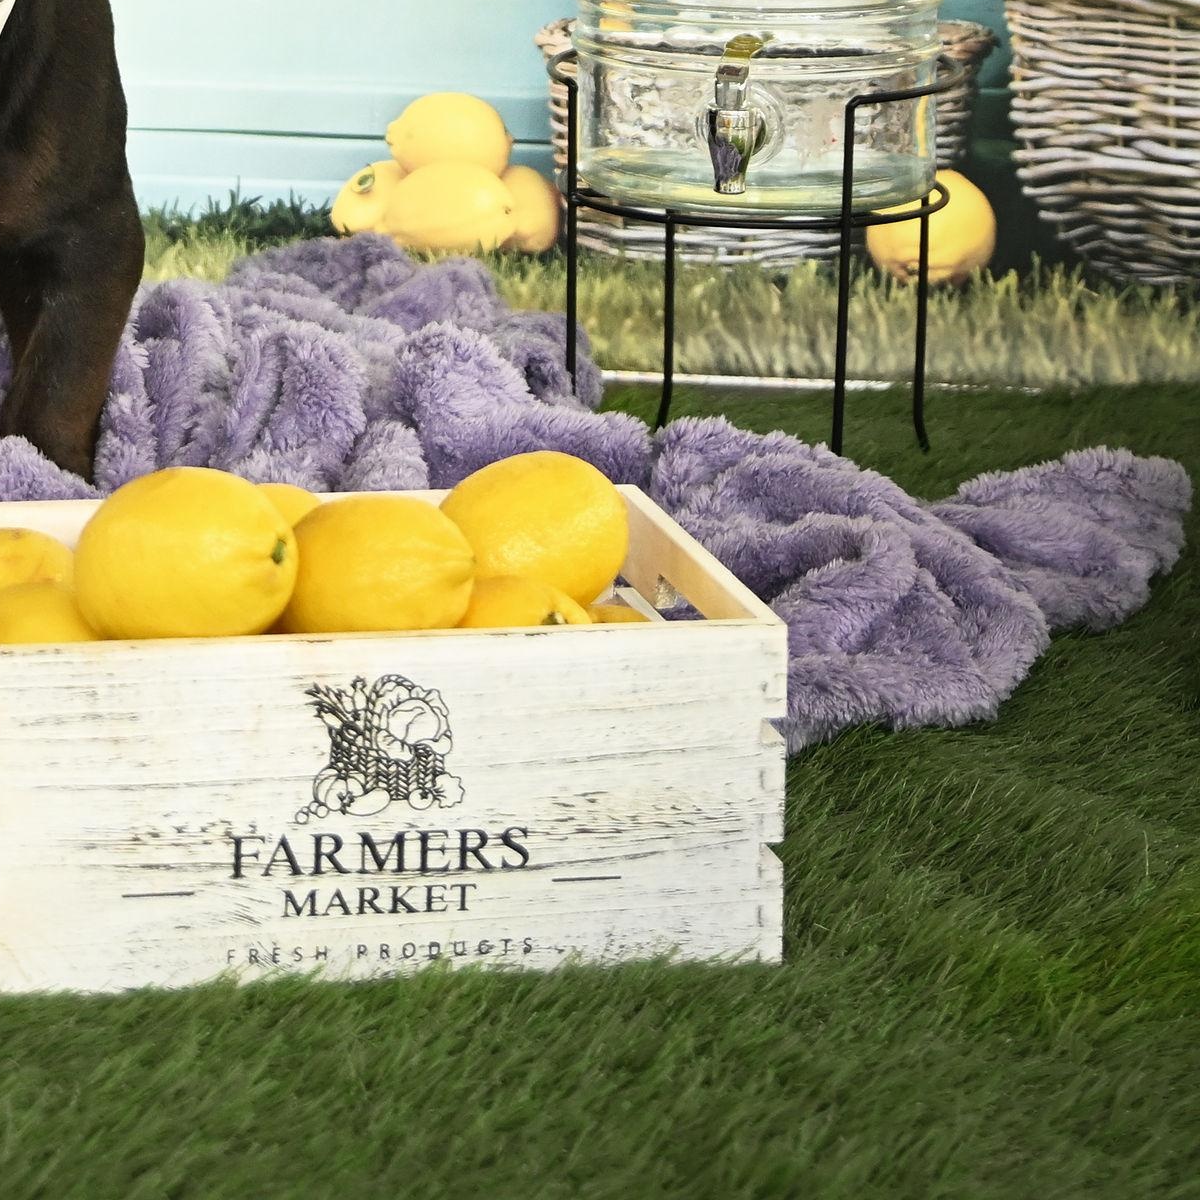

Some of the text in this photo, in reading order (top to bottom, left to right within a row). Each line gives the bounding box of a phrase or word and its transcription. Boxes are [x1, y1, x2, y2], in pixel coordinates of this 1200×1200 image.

[230, 826, 530, 879] FARMERS
[281, 883, 477, 918] MARKET
[227, 937, 533, 965] FRESH PRODUCTS
